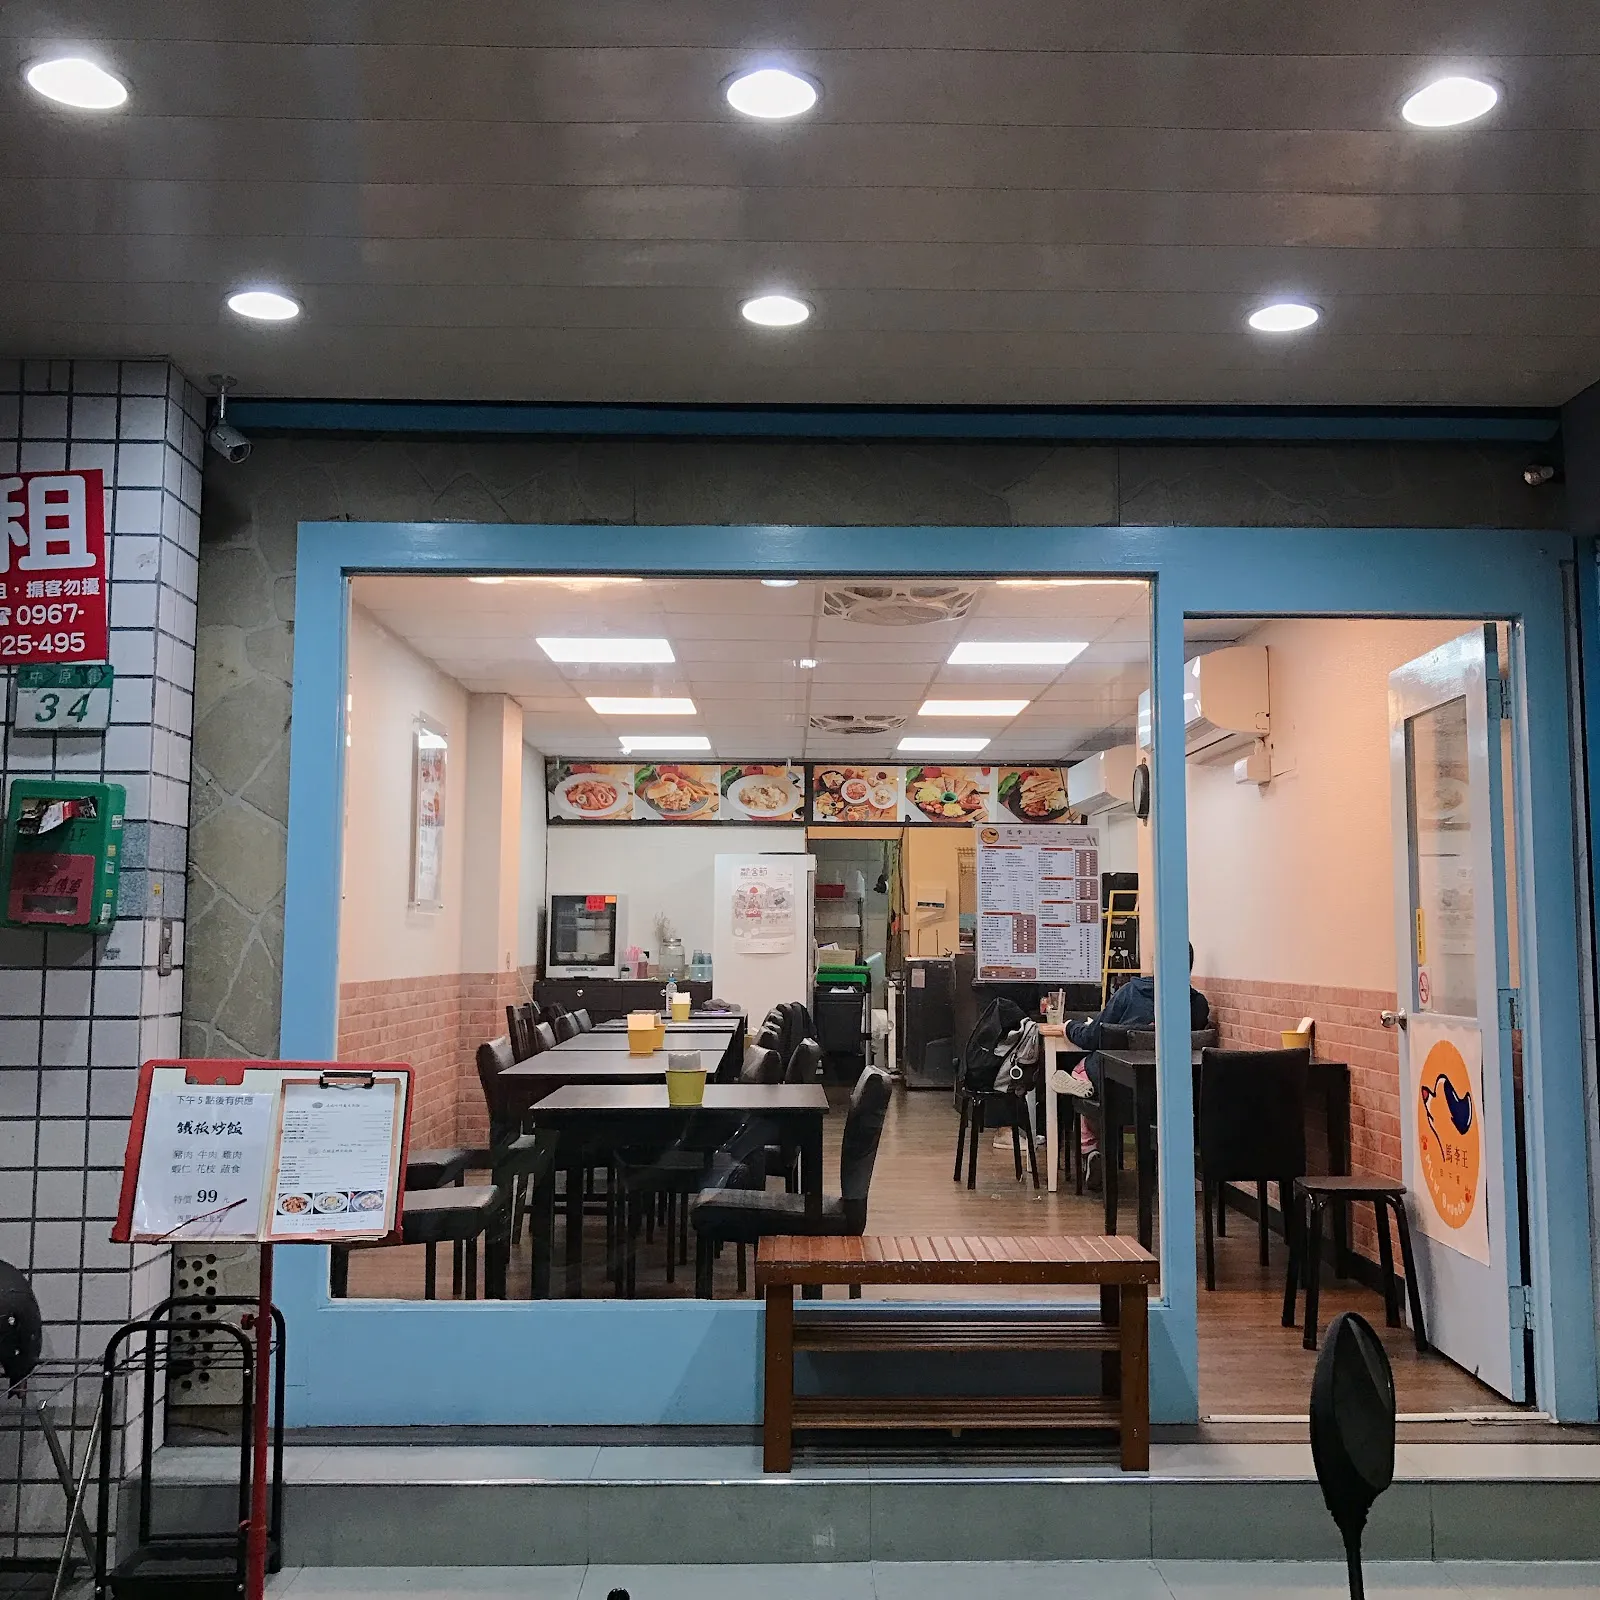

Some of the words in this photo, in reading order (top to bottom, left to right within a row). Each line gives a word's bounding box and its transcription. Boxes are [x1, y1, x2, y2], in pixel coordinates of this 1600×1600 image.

[0, 475, 96, 573] 租
[16, 603, 84, 625] 0967-
[0, 632, 85, 655] 25-495
[35, 693, 88, 722] 34
[197, 1189, 218, 1203] 99
